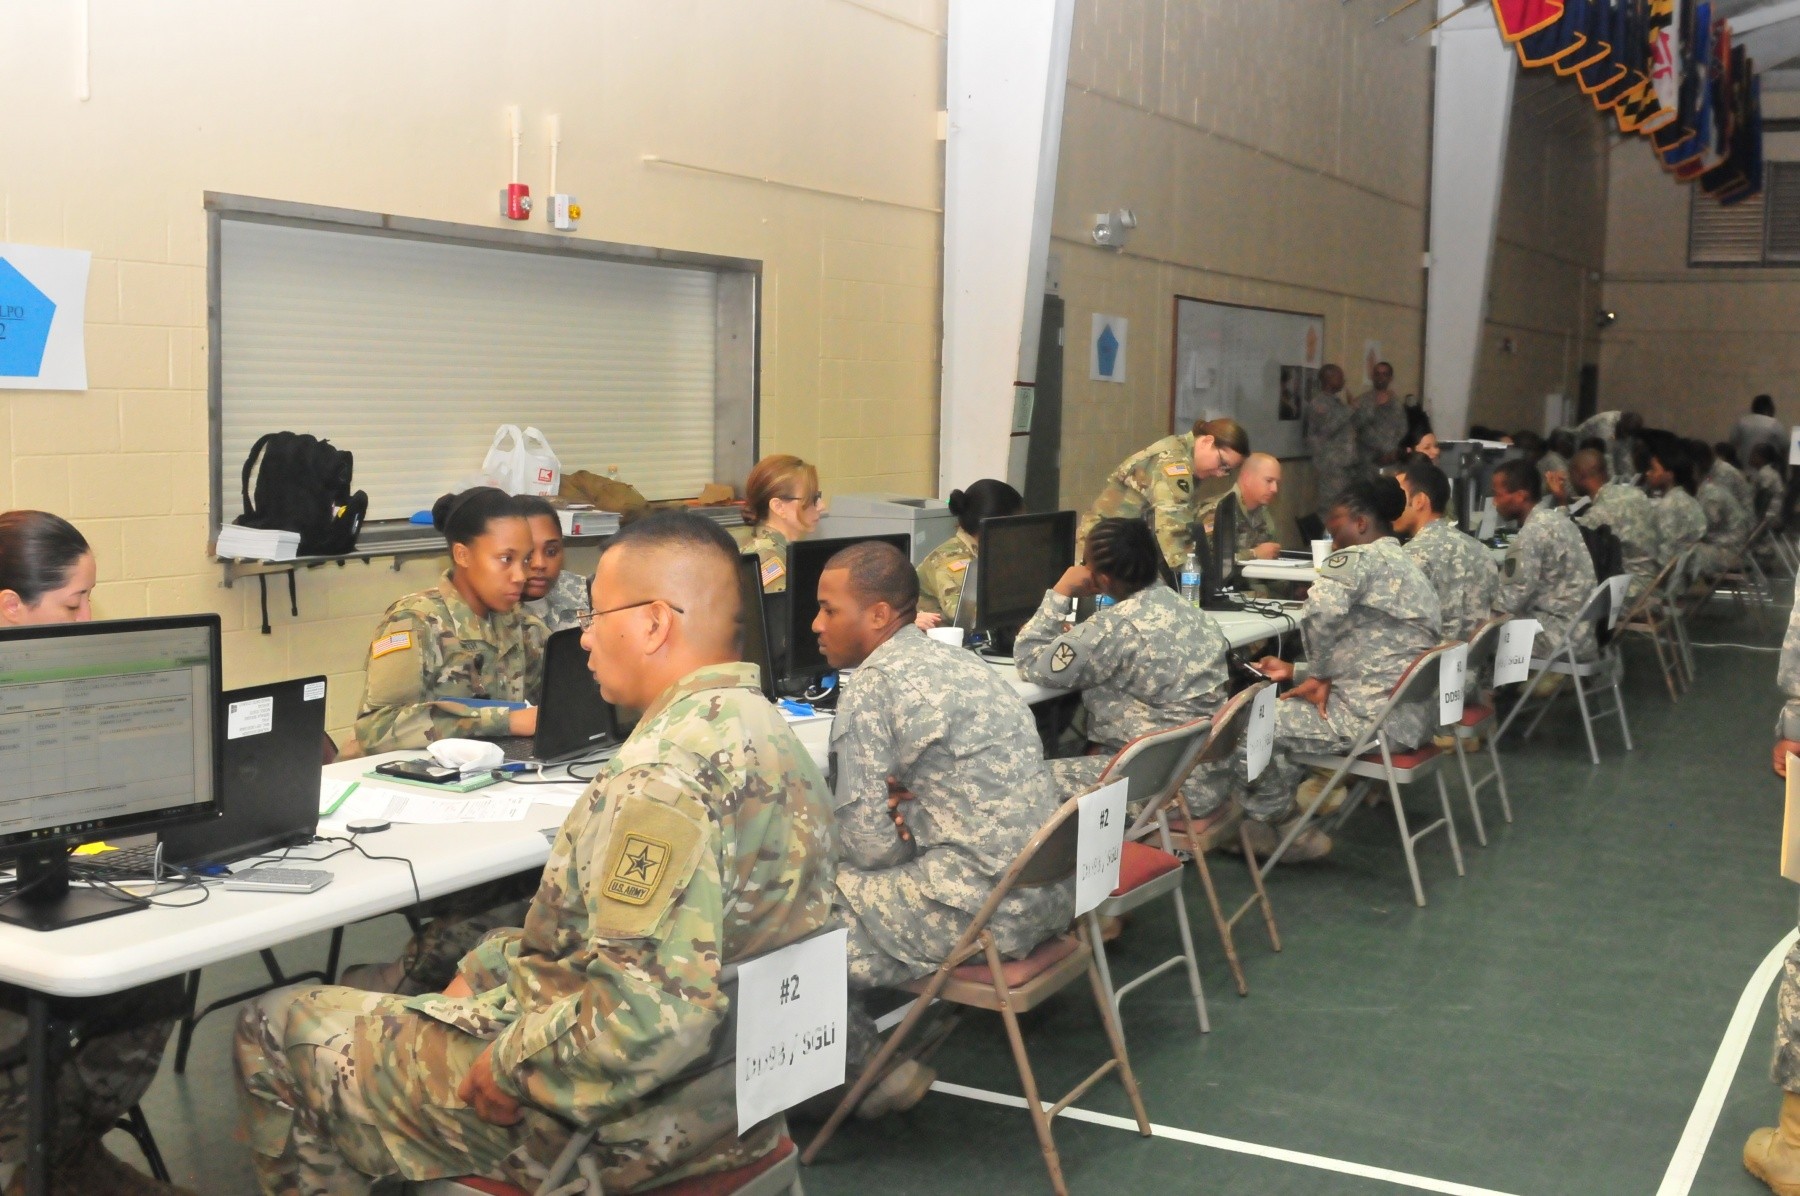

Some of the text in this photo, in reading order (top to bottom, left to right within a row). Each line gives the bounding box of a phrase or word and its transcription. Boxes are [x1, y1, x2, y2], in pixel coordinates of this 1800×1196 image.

[1100, 808, 1109, 830] #2
[611, 882, 646, 897] U.S. ARMY
[780, 974, 800, 1006] #2
[803, 1022, 835, 1056] SGLI
